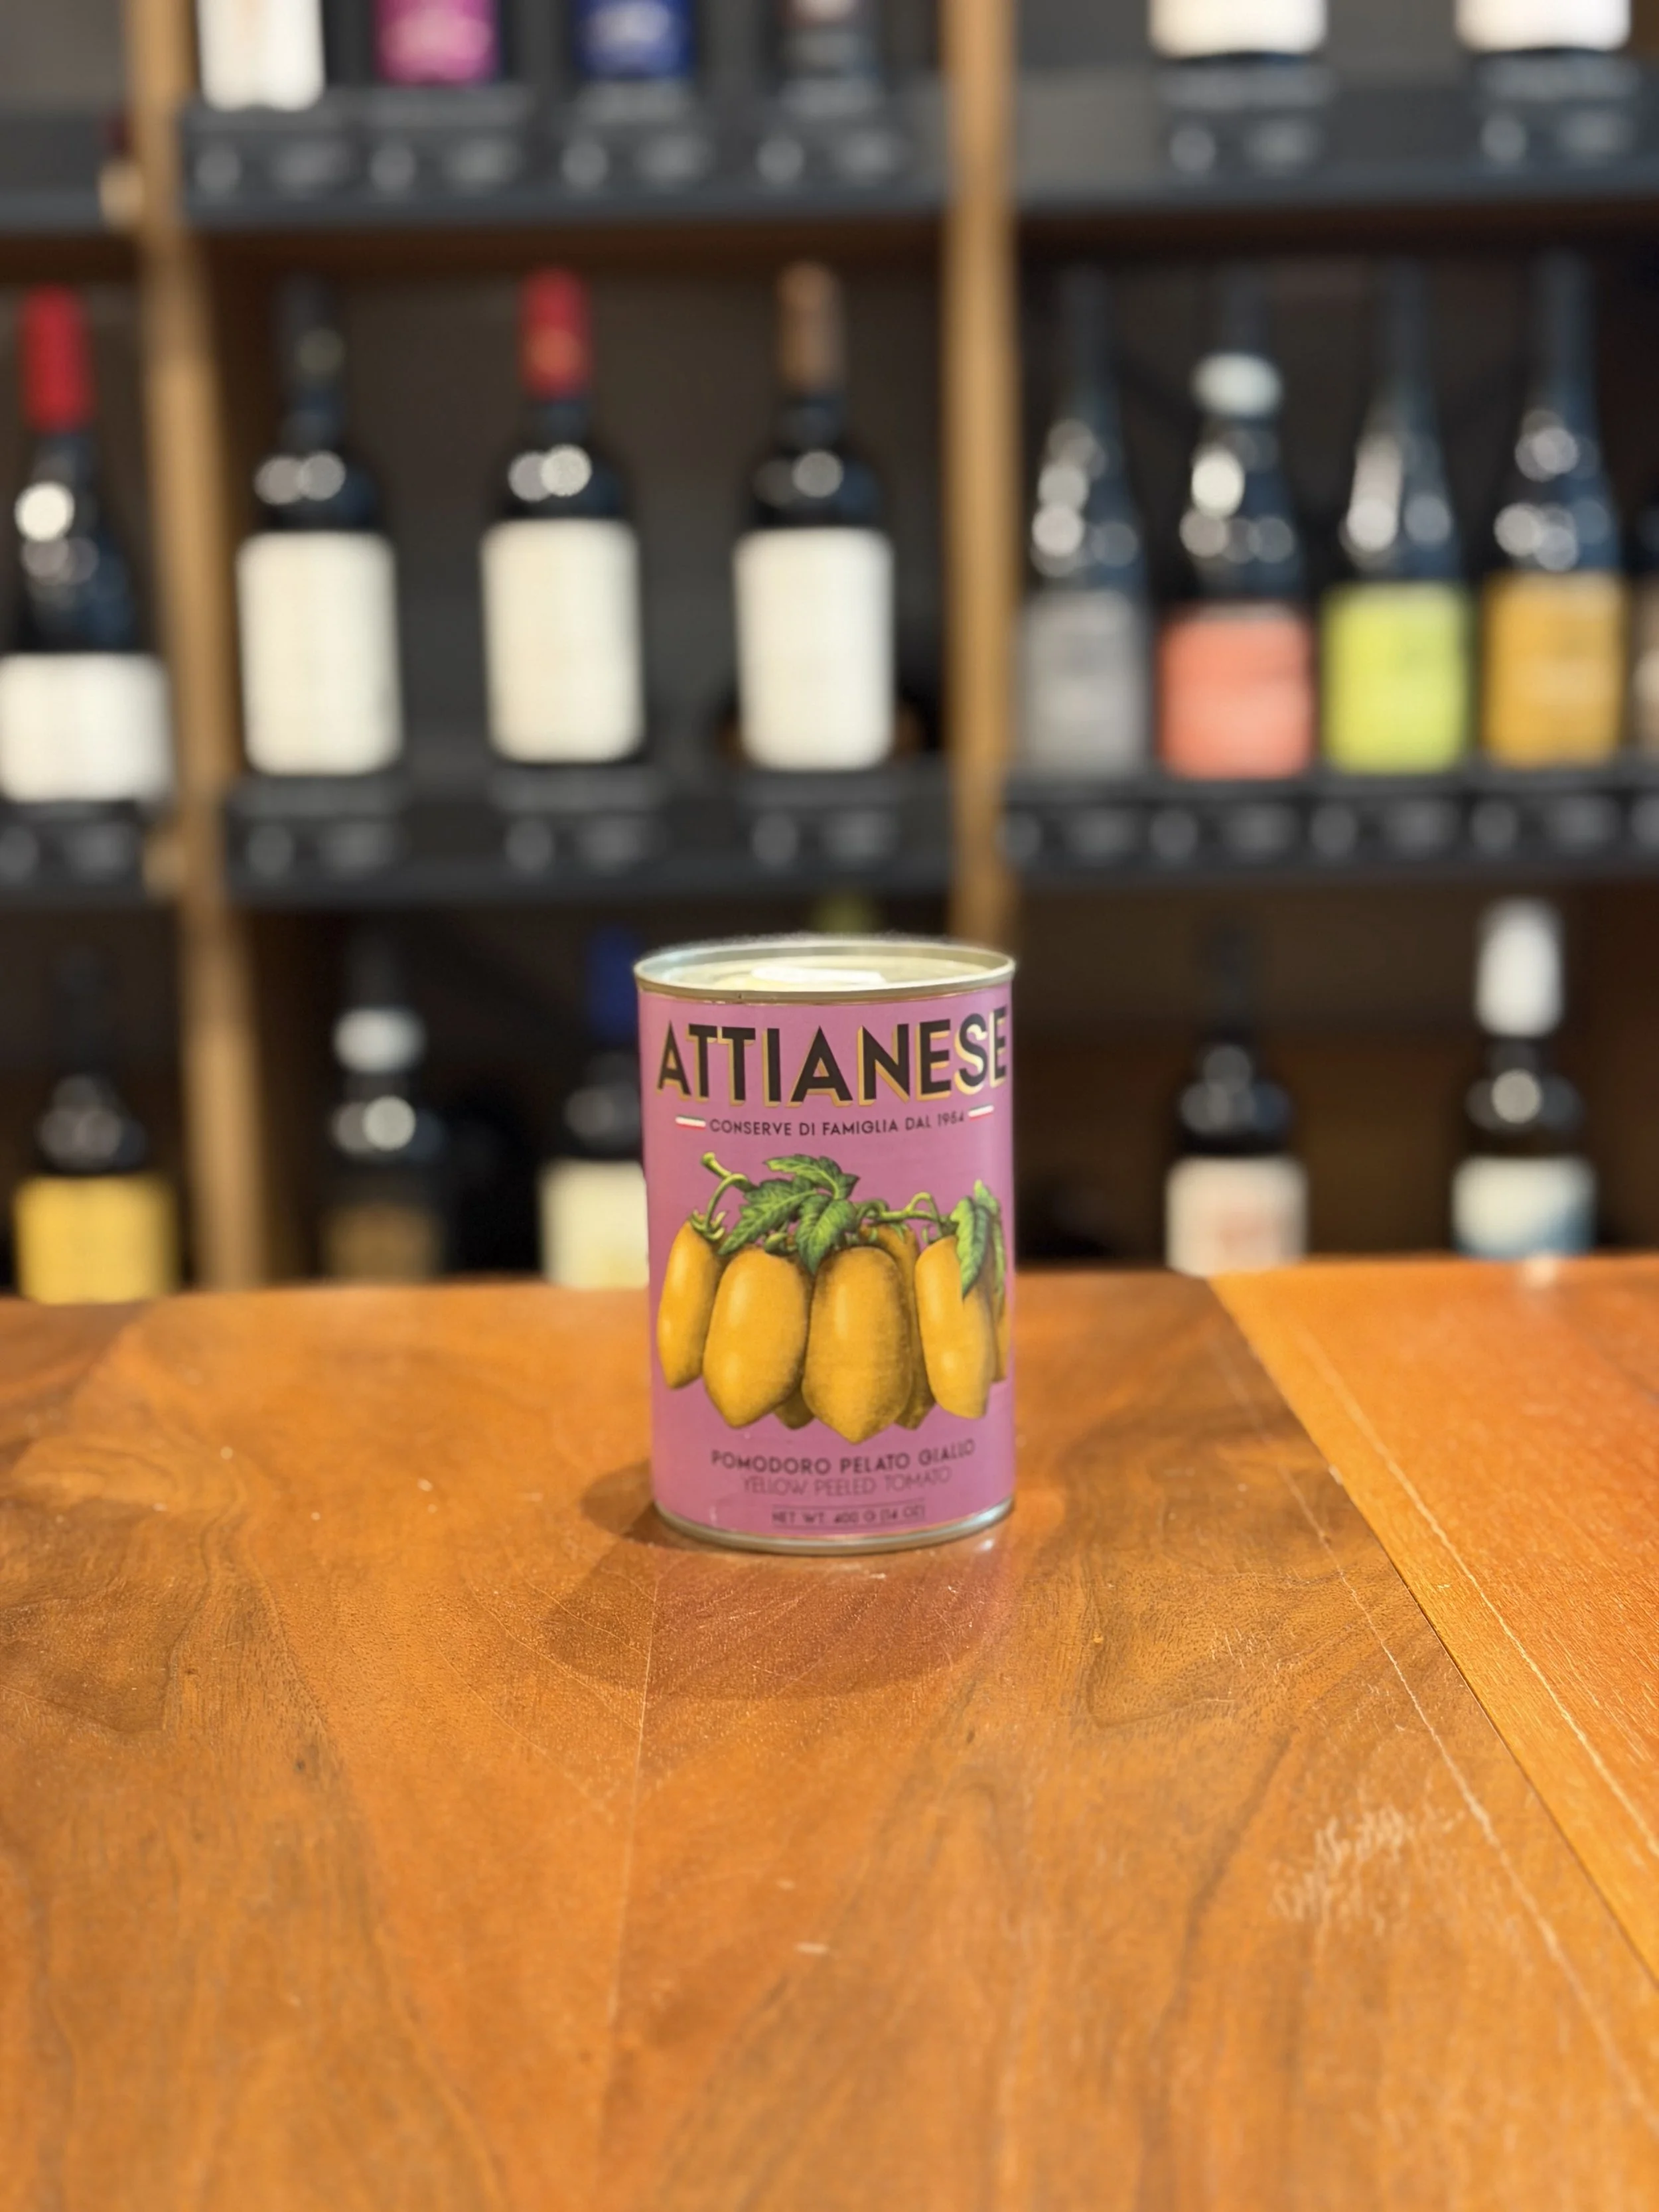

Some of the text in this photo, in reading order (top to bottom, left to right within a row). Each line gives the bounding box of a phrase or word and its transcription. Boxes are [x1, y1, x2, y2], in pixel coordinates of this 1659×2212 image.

[657, 1005, 1007, 1108] ATTIANESE
[709, 1118, 792, 1136] CONSERVE
[798, 1122, 816, 1136] DI
[822, 1116, 899, 1136] FAMIGLIA
[905, 1116, 931, 1131] DAL
[711, 1438, 975, 1475] POMODORO PELATO GIALLO
[743, 1465, 952, 1496] YELLOW PEELED TOMATO
